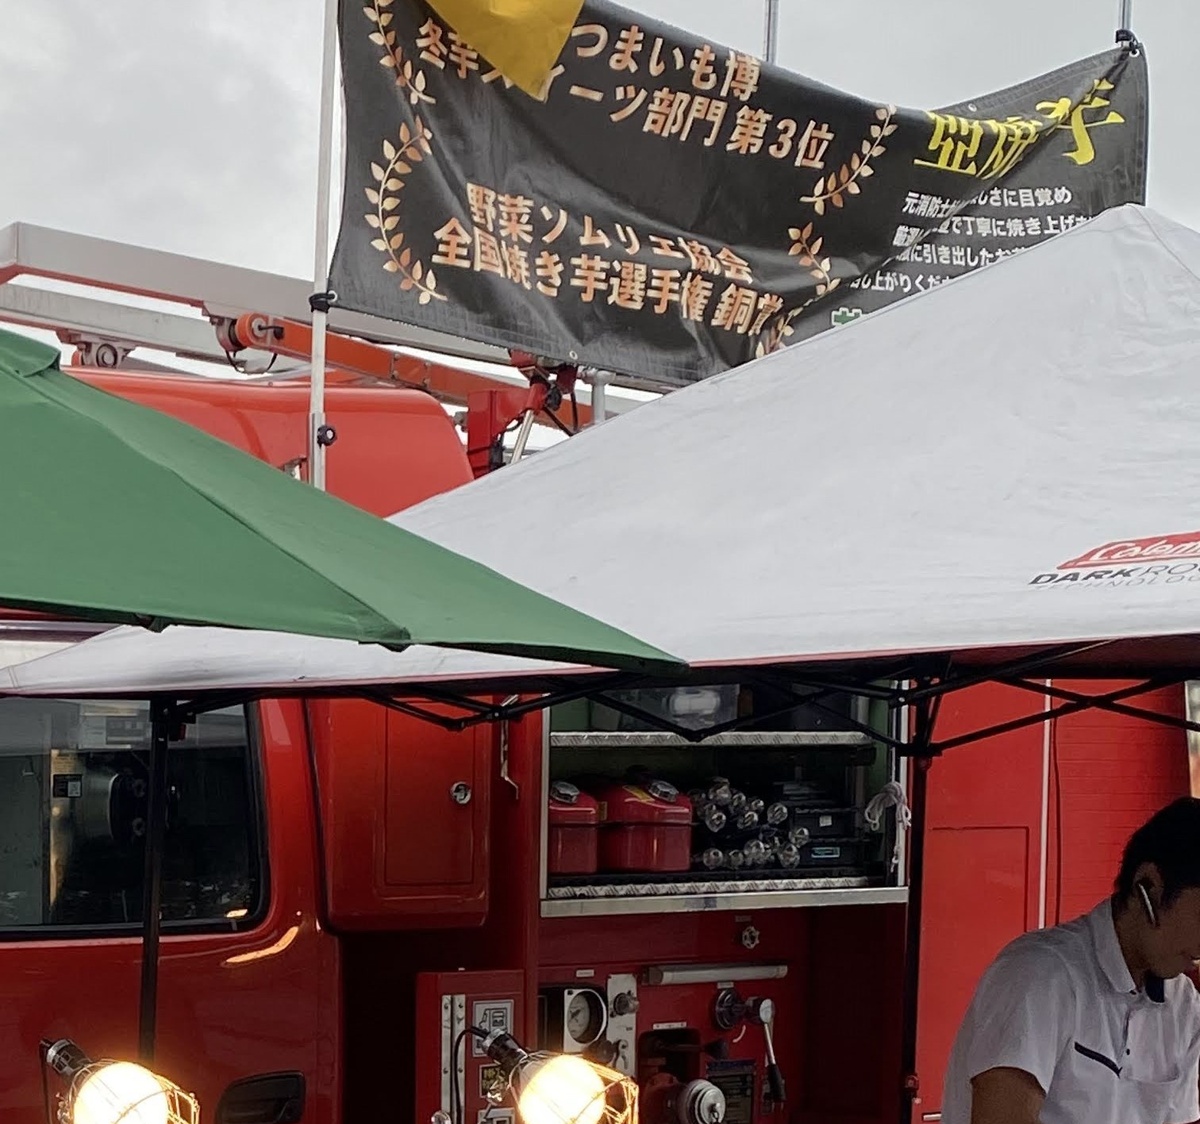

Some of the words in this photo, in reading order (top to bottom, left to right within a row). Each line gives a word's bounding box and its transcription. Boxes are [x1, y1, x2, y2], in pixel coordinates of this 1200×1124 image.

[467, 182, 754, 284] 野菜ソムリエ協会
[1028, 562, 1200, 585] DARKRO
